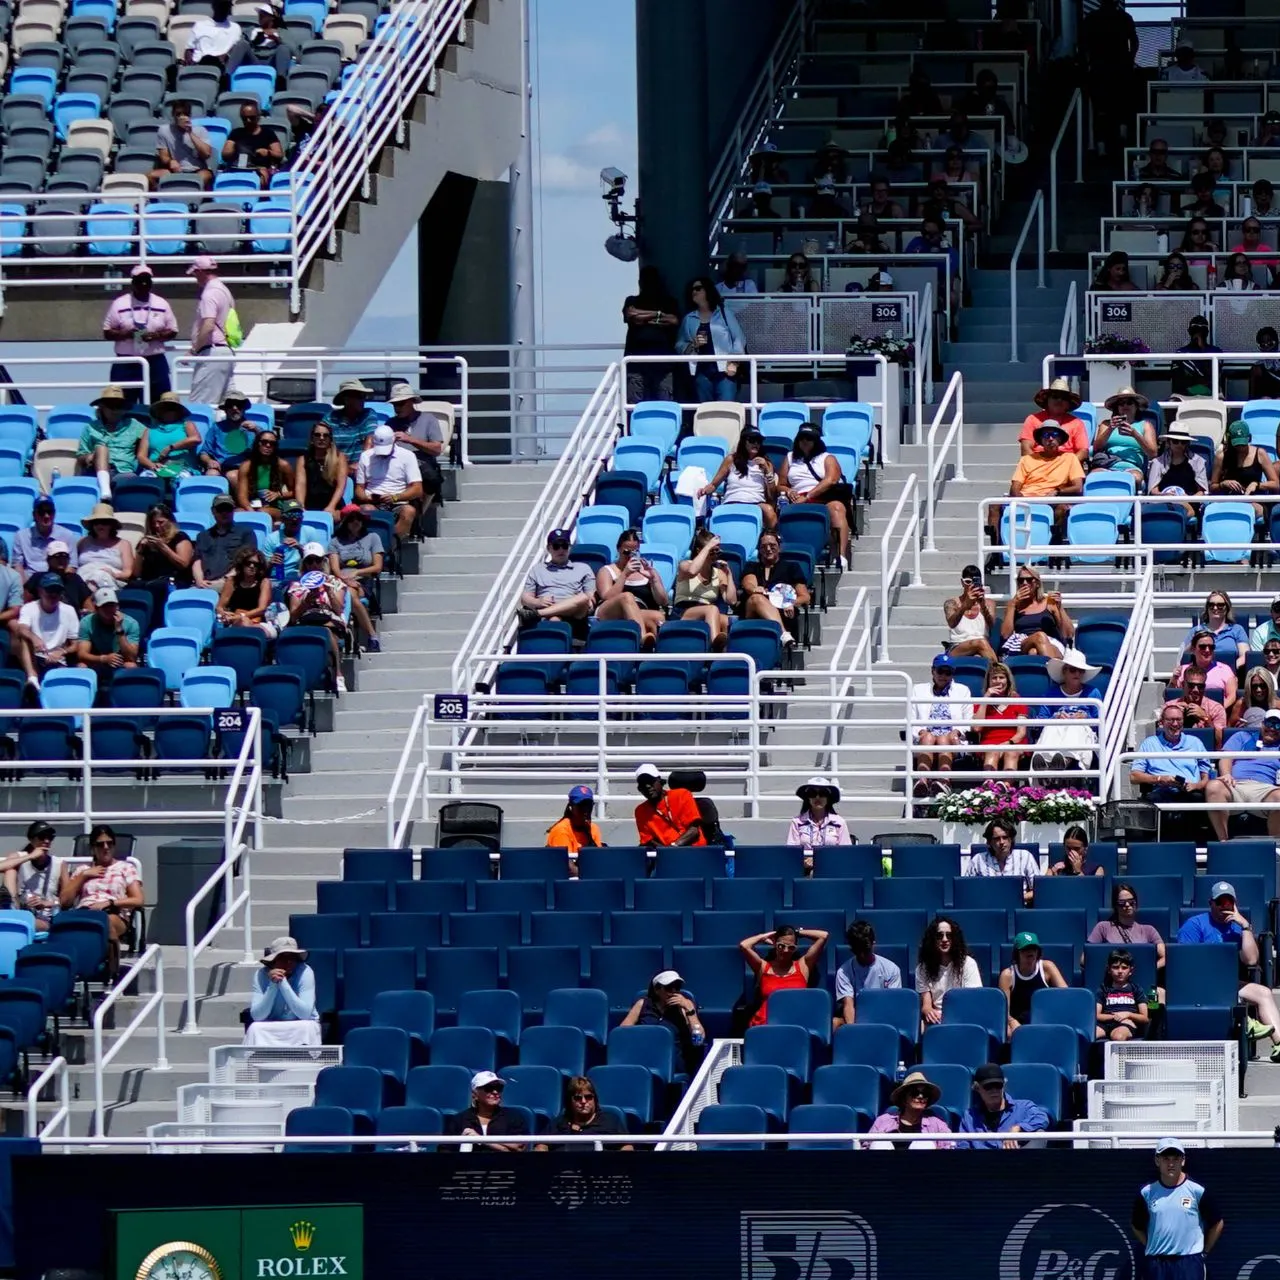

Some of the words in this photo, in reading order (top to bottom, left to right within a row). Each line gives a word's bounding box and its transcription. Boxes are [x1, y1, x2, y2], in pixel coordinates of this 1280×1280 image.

[876, 307, 897, 317] 306
[1107, 307, 1128, 317] 306
[439, 703, 463, 714] 205
[218, 716, 242, 727] 204
[257, 1256, 348, 1277] ROLEX
